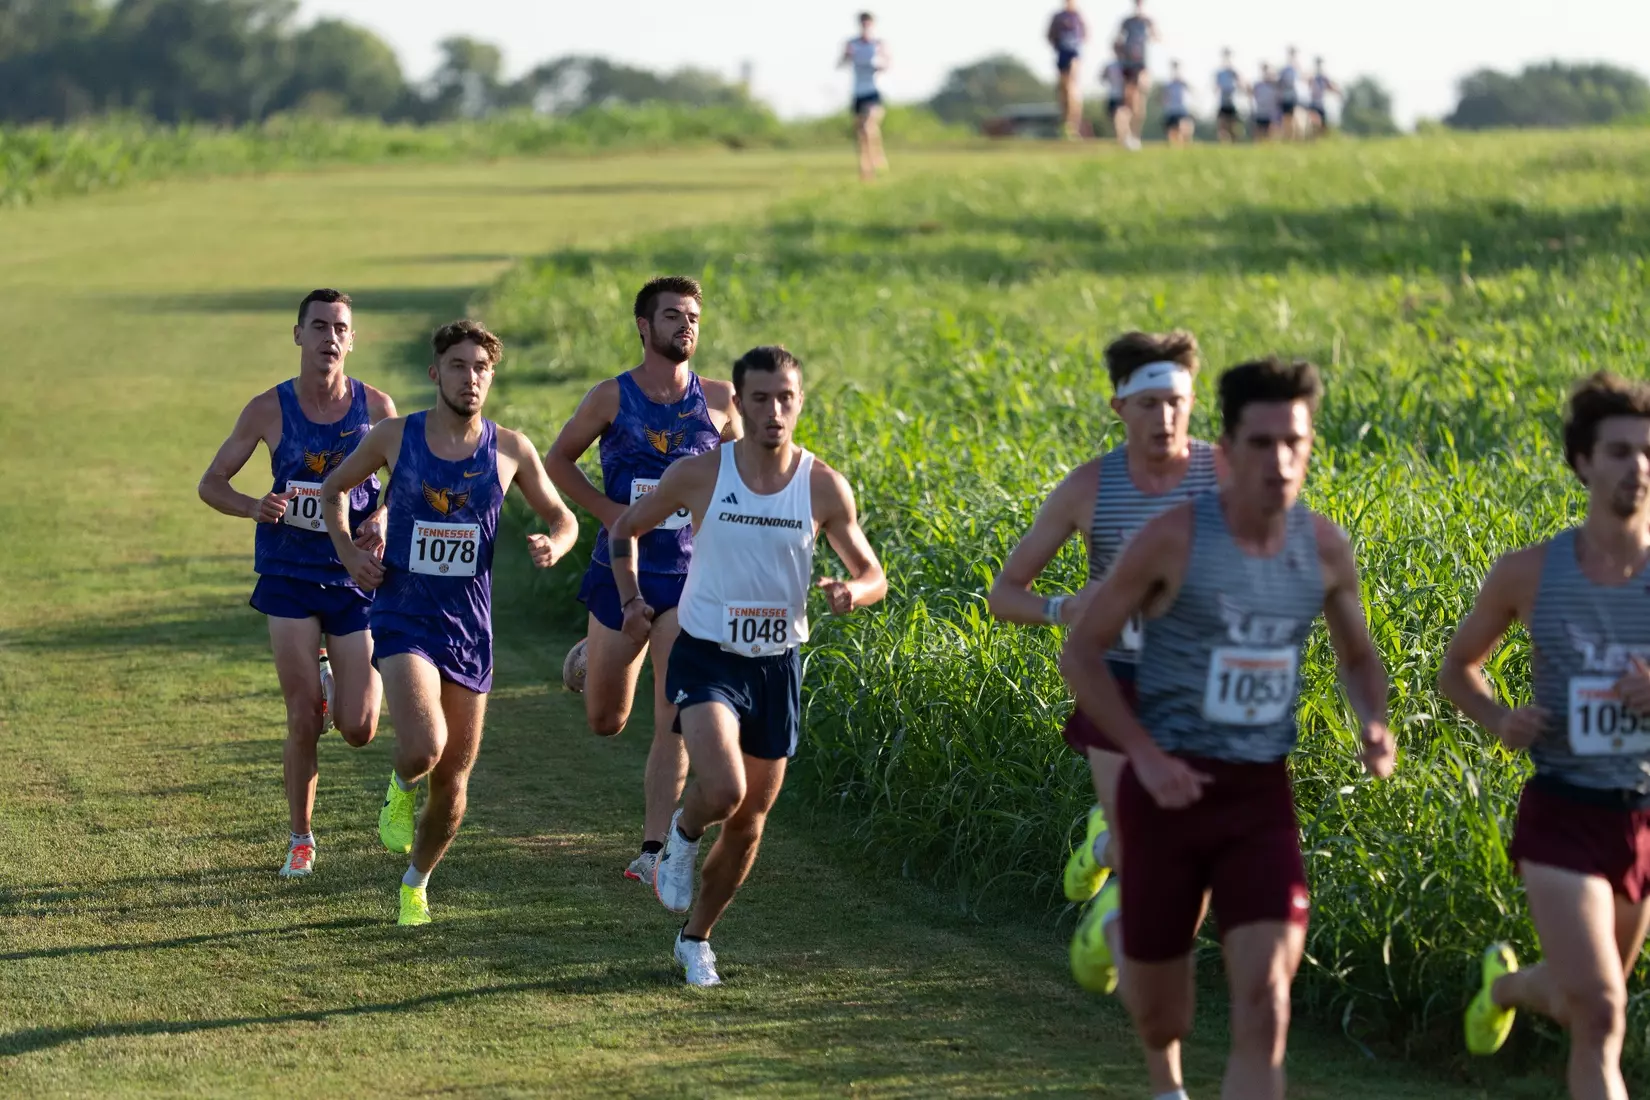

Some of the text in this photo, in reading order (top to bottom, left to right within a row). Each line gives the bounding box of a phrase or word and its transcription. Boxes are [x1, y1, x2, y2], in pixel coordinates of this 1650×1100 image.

[291, 486, 322, 496] TENNE
[290, 496, 323, 519] 10
[719, 512, 803, 529] CHATTANOOGA
[418, 527, 476, 538] TENNESSEE
[416, 538, 475, 563] 1078
[729, 607, 788, 617] TENNESSEE
[728, 618, 787, 643] 1048
